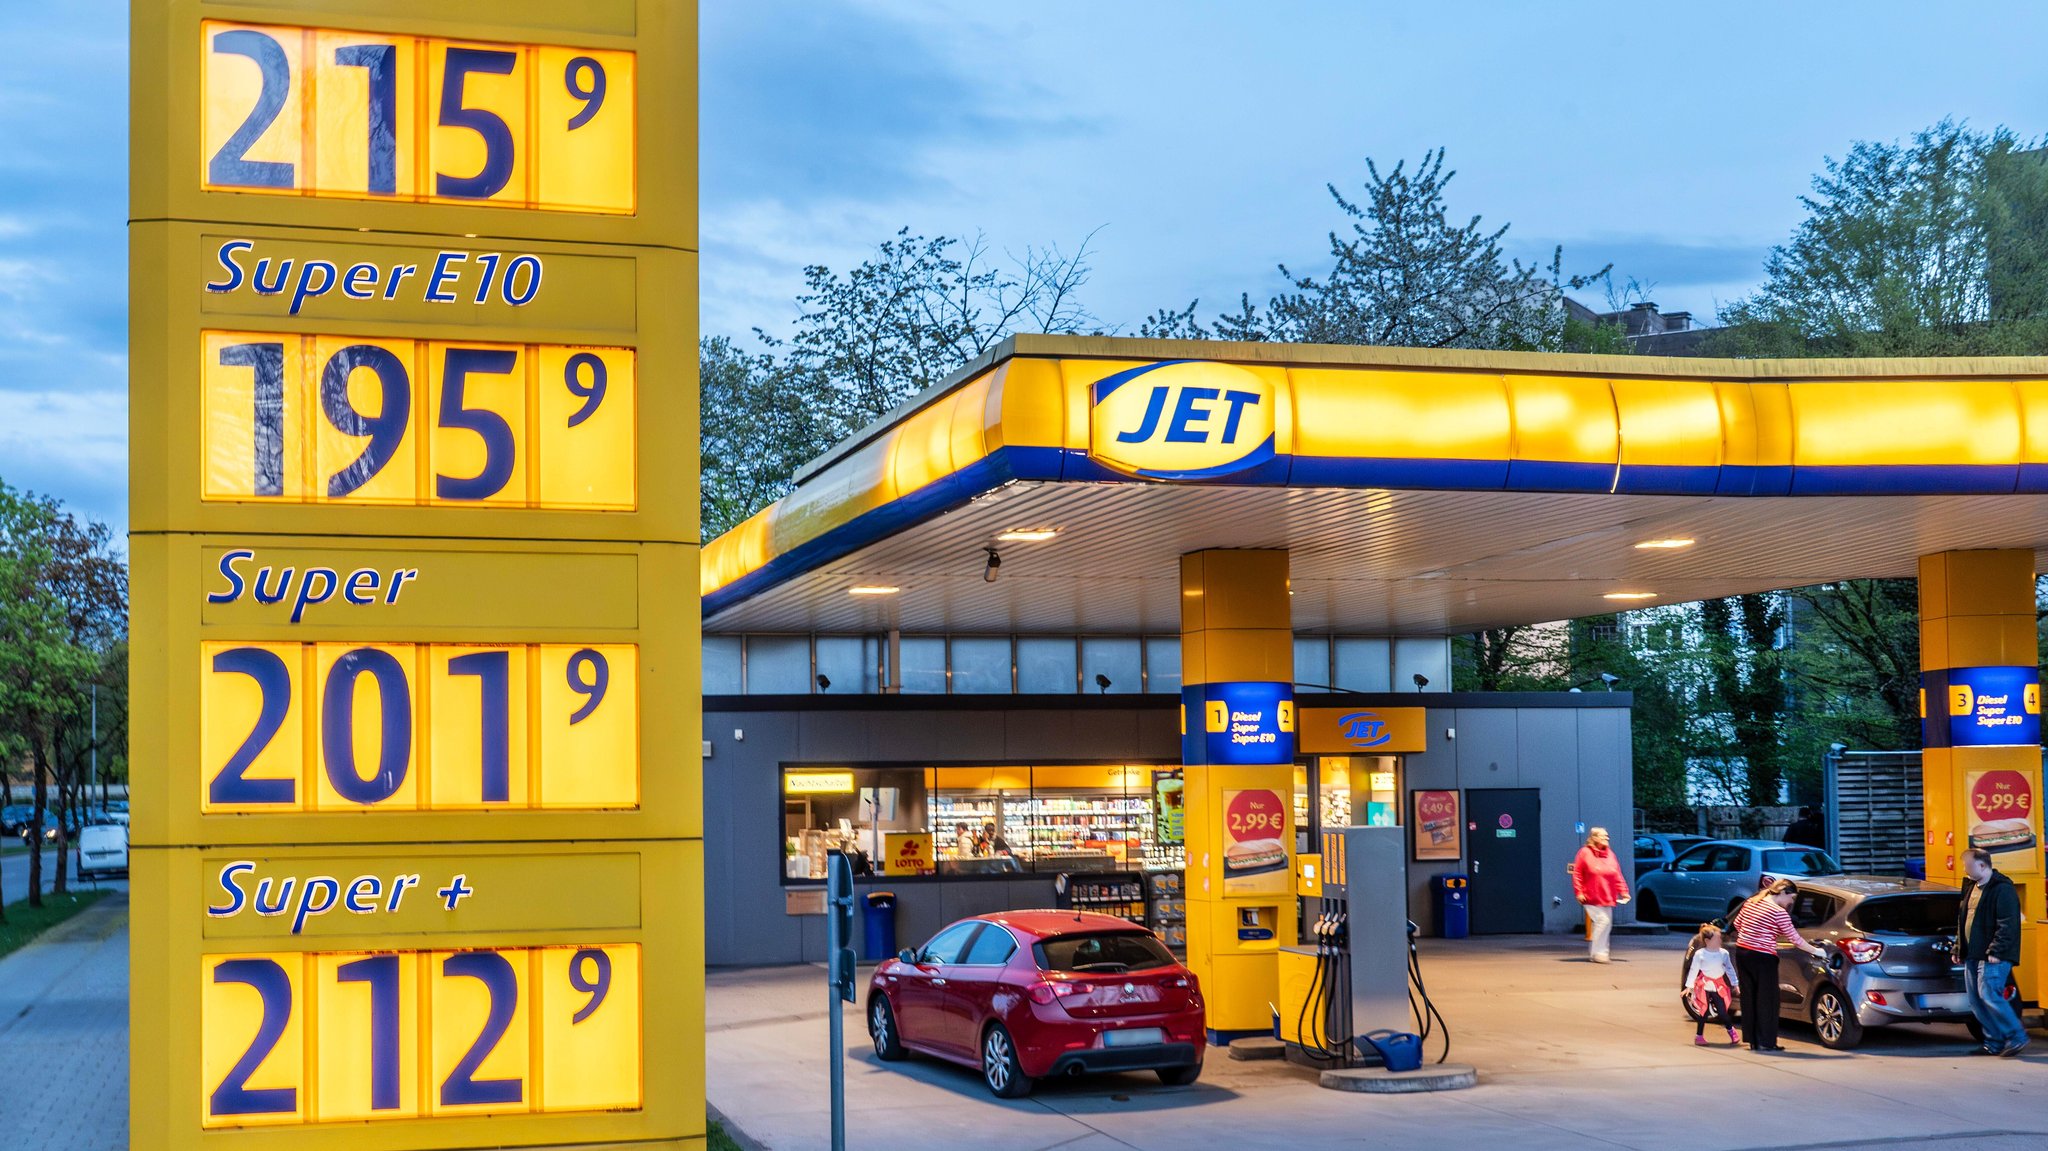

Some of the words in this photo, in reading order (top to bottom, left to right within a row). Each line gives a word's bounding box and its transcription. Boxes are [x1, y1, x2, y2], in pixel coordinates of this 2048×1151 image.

[206, 239, 418, 317] Super
[424, 250, 544, 308] E10
[1115, 385, 1262, 445] JET
[207, 548, 419, 625] Super
[1957, 693, 1967, 708] 3
[1976, 694, 2009, 705] Diesel
[2028, 691, 2037, 706] 4
[1214, 709, 1222, 724] 1
[1231, 711, 1262, 722] Diesel
[1282, 709, 1290, 724] 2
[1976, 706, 2006, 717] Super
[1231, 722, 1260, 735] Super
[1976, 716, 2006, 728] Super
[2005, 715, 2023, 725] E10
[1344, 720, 1386, 739] JET
[1231, 733, 1260, 746] Super
[1259, 732, 1276, 743] E10
[1249, 801, 1265, 810] Nur
[895, 858, 924, 869] LOTTO
[207, 860, 421, 937] Super
[436, 873, 474, 913] +
